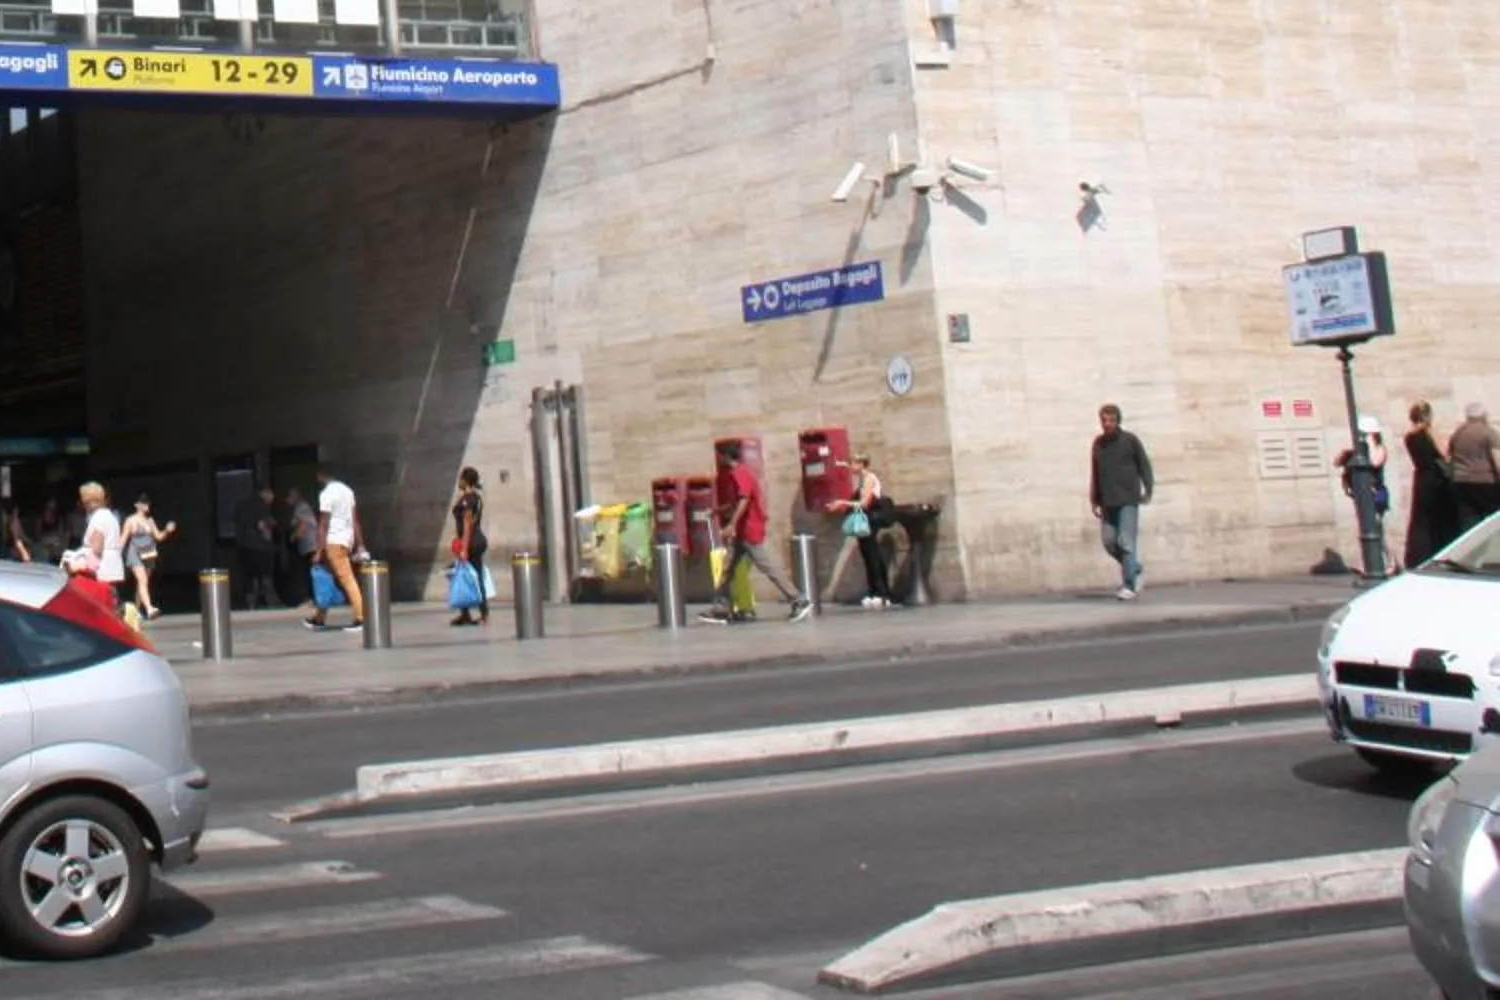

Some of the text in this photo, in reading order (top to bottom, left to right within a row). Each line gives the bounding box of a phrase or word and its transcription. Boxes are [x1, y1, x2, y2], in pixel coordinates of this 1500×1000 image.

[133, 57, 186, 73] Binari
[371, 64, 538, 87] Fiumicino Aeroporto
